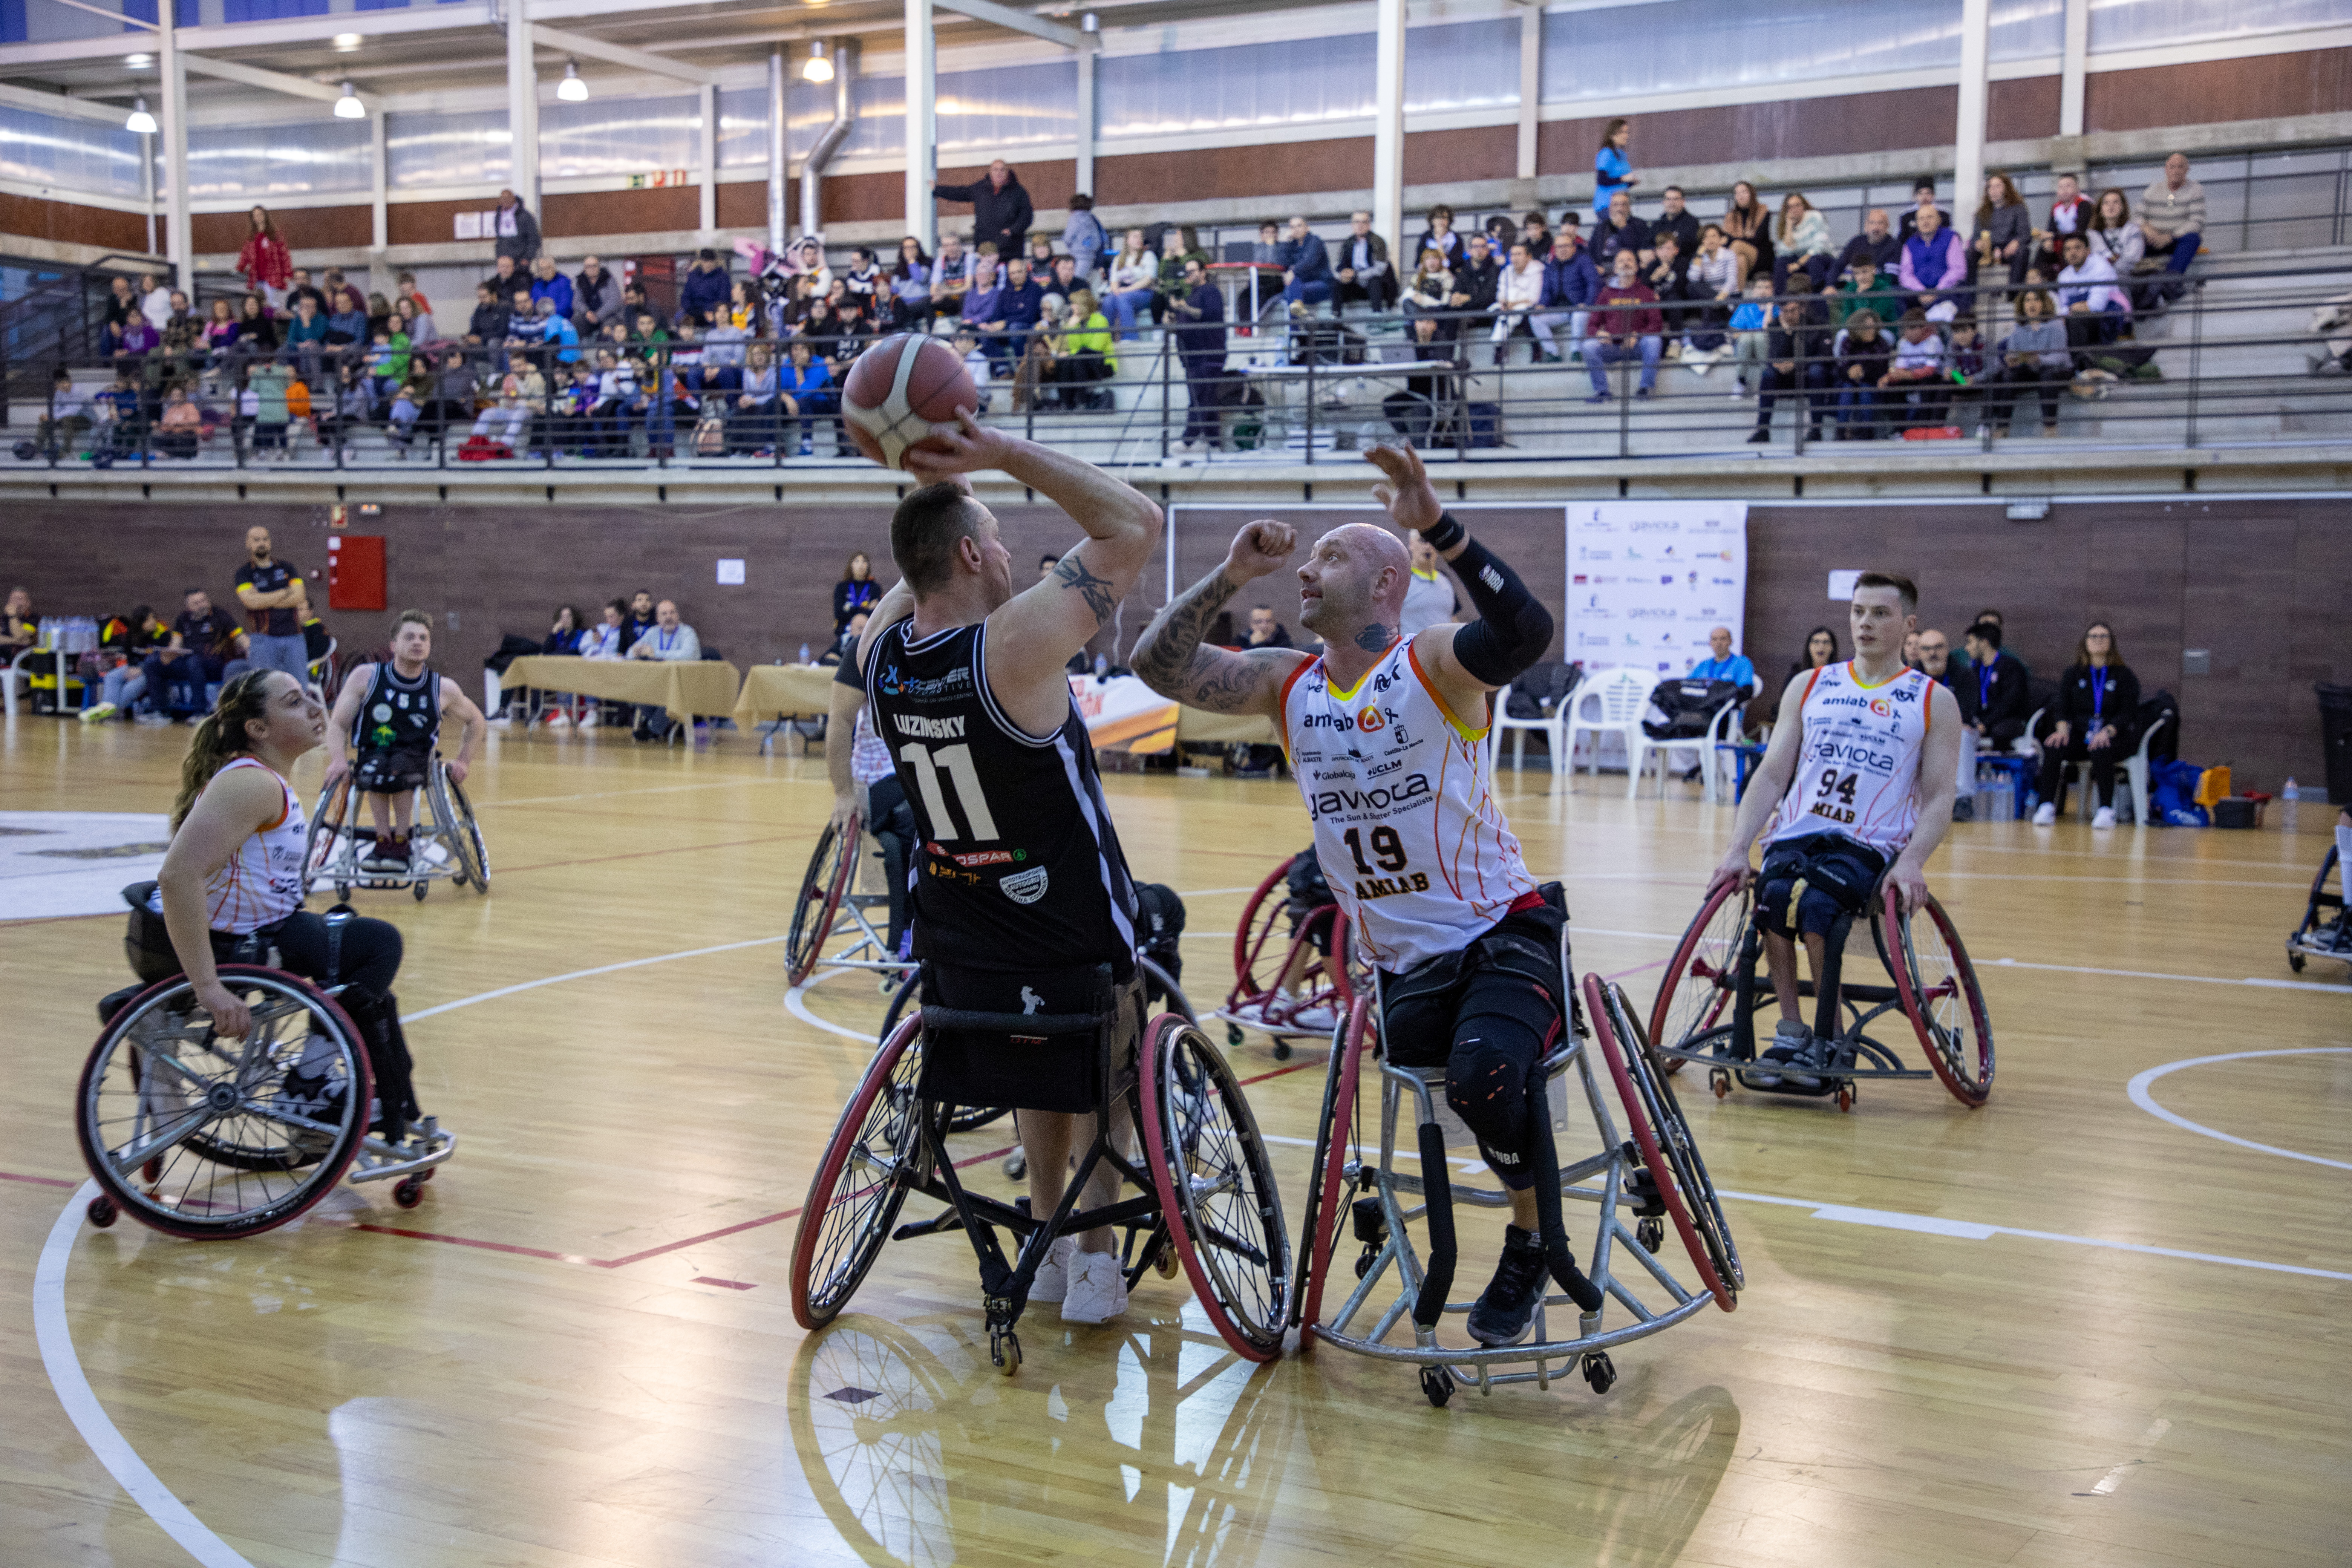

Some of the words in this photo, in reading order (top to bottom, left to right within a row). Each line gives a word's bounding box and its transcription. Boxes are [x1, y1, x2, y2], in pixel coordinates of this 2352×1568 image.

[893, 714, 965, 739] LUZINSKY
[1304, 713, 1354, 732] amab
[1322, 770, 1356, 780] Globalcaja
[1372, 759, 1402, 774] UCLM
[900, 742, 1000, 841] 11
[1817, 769, 1858, 805] 94
[1393, 796, 1433, 815] Specialists
[1808, 801, 1856, 824] MIAB
[1343, 825, 1408, 875] 19
[1355, 871, 1430, 900] AMIAB
